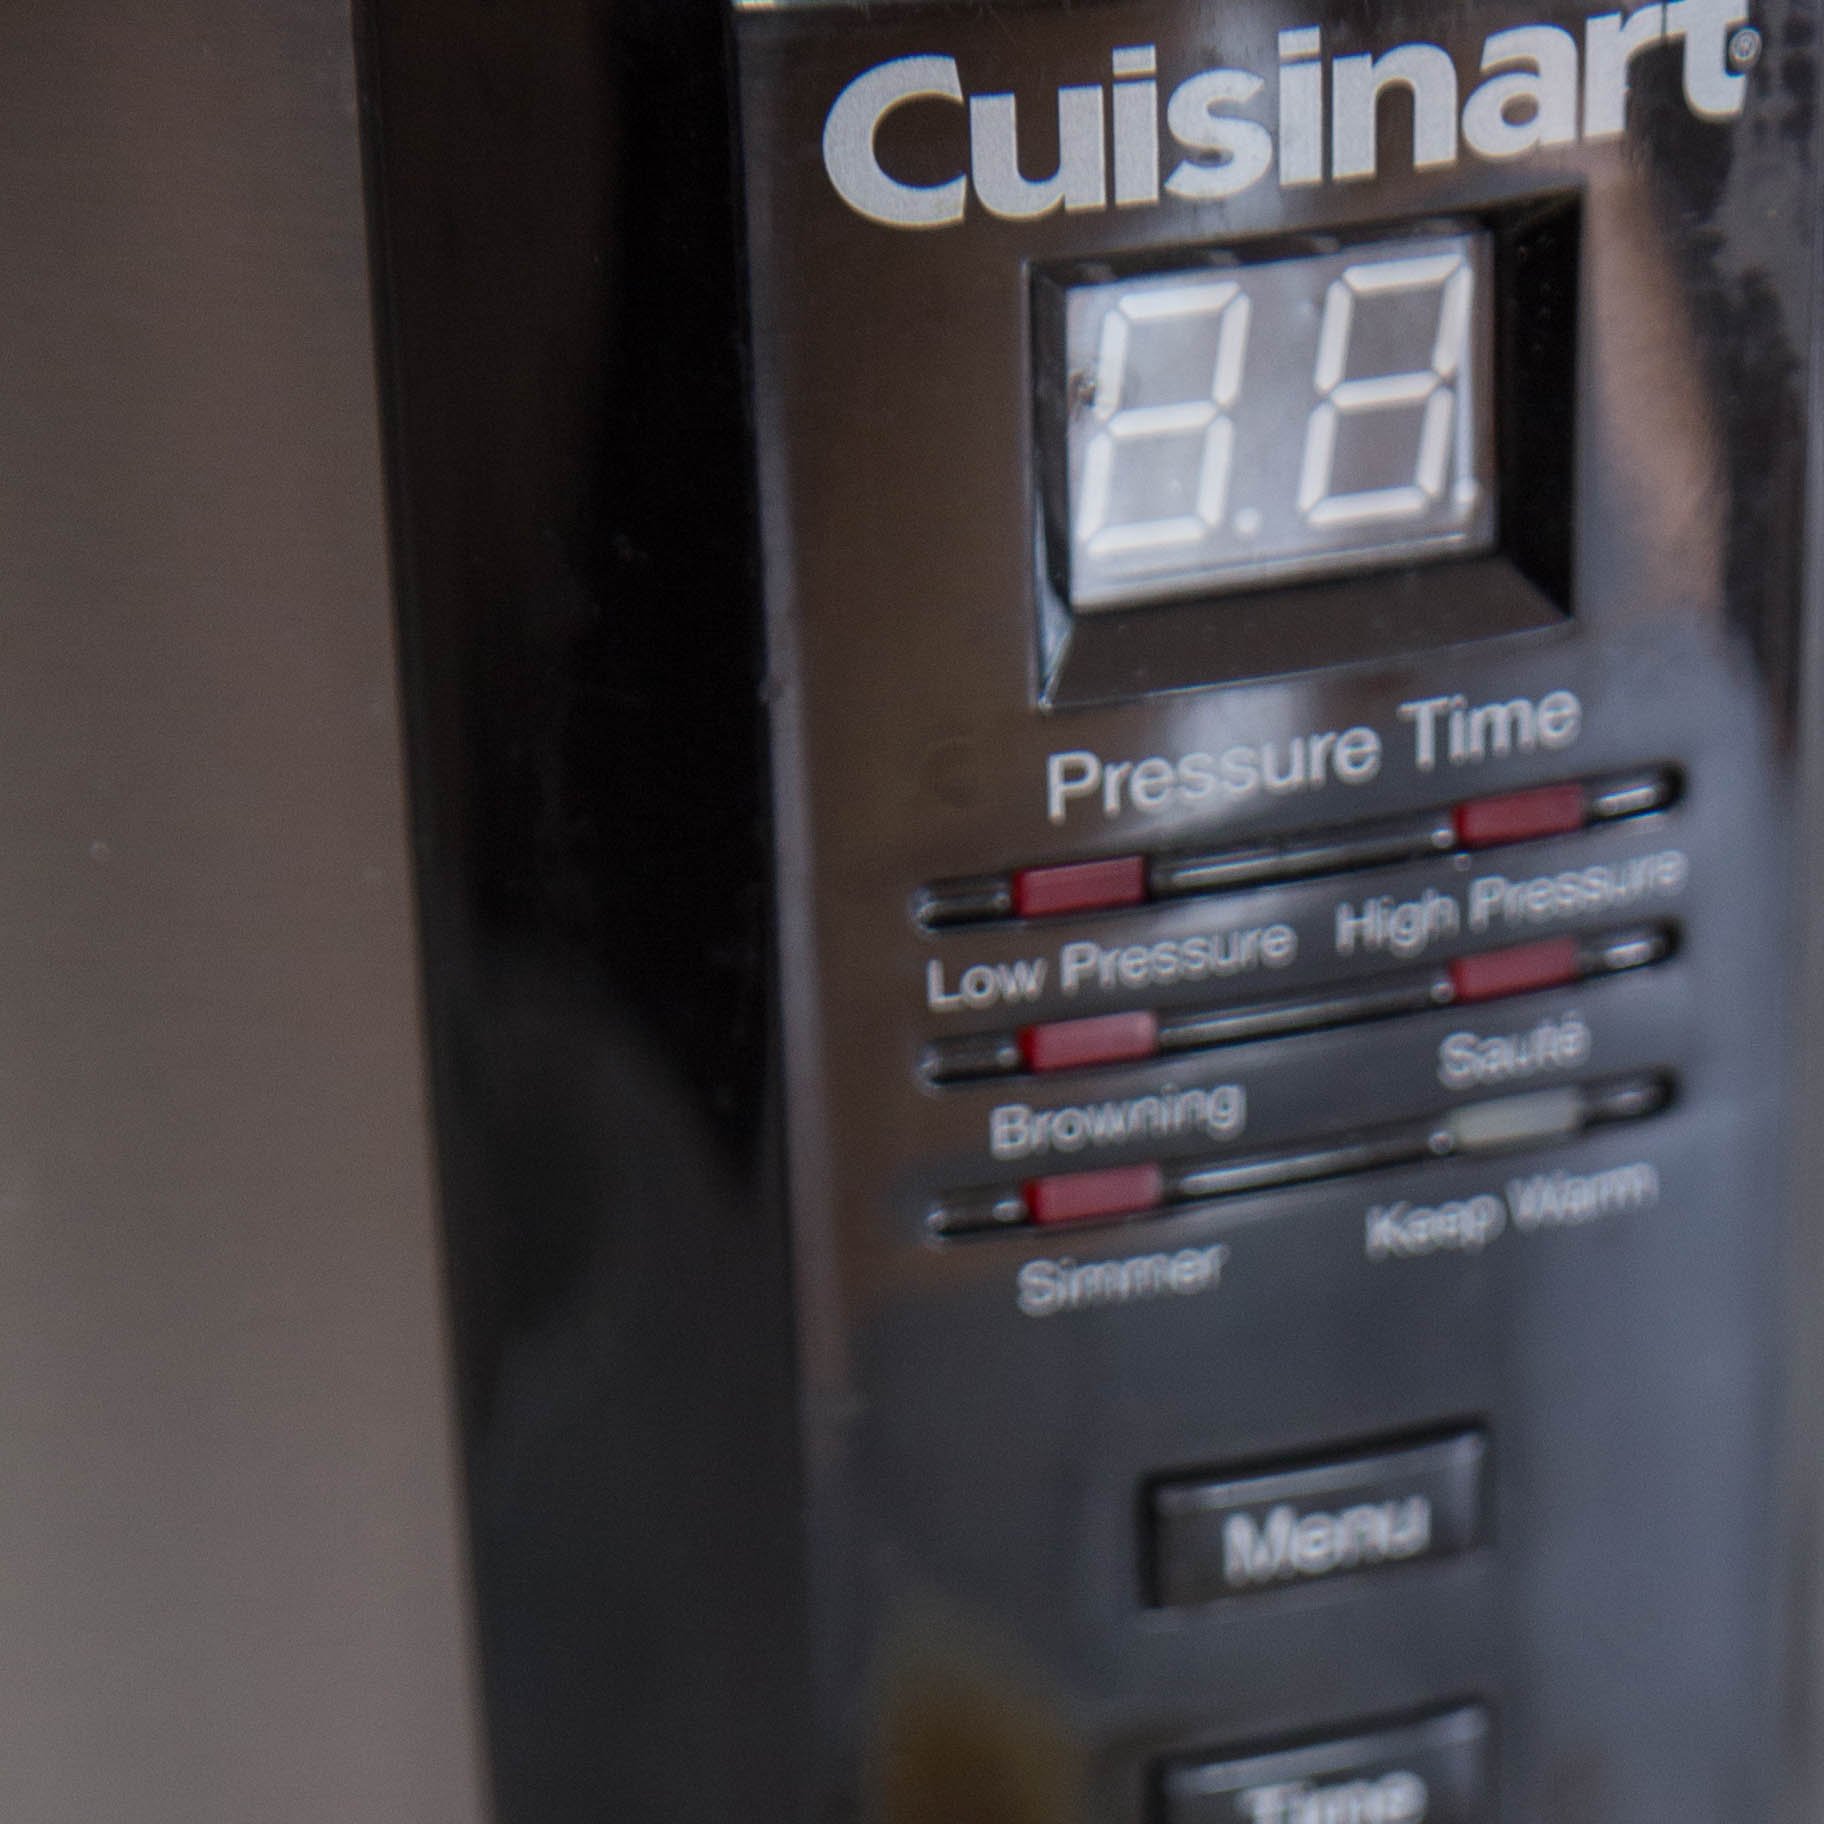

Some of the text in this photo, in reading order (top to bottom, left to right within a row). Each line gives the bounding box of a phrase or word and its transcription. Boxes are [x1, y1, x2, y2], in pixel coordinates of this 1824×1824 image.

[1045, 689, 1583, 822] Pressure Time
[1335, 850, 1688, 958] High Pressure
[926, 919, 1298, 1013] Low Pressure
[989, 1082, 1247, 1158] Browning
[1364, 1162, 1659, 1262] Keep Warm
[1018, 1243, 1231, 1317] Simmer
[1223, 1490, 1431, 1585] Menu
